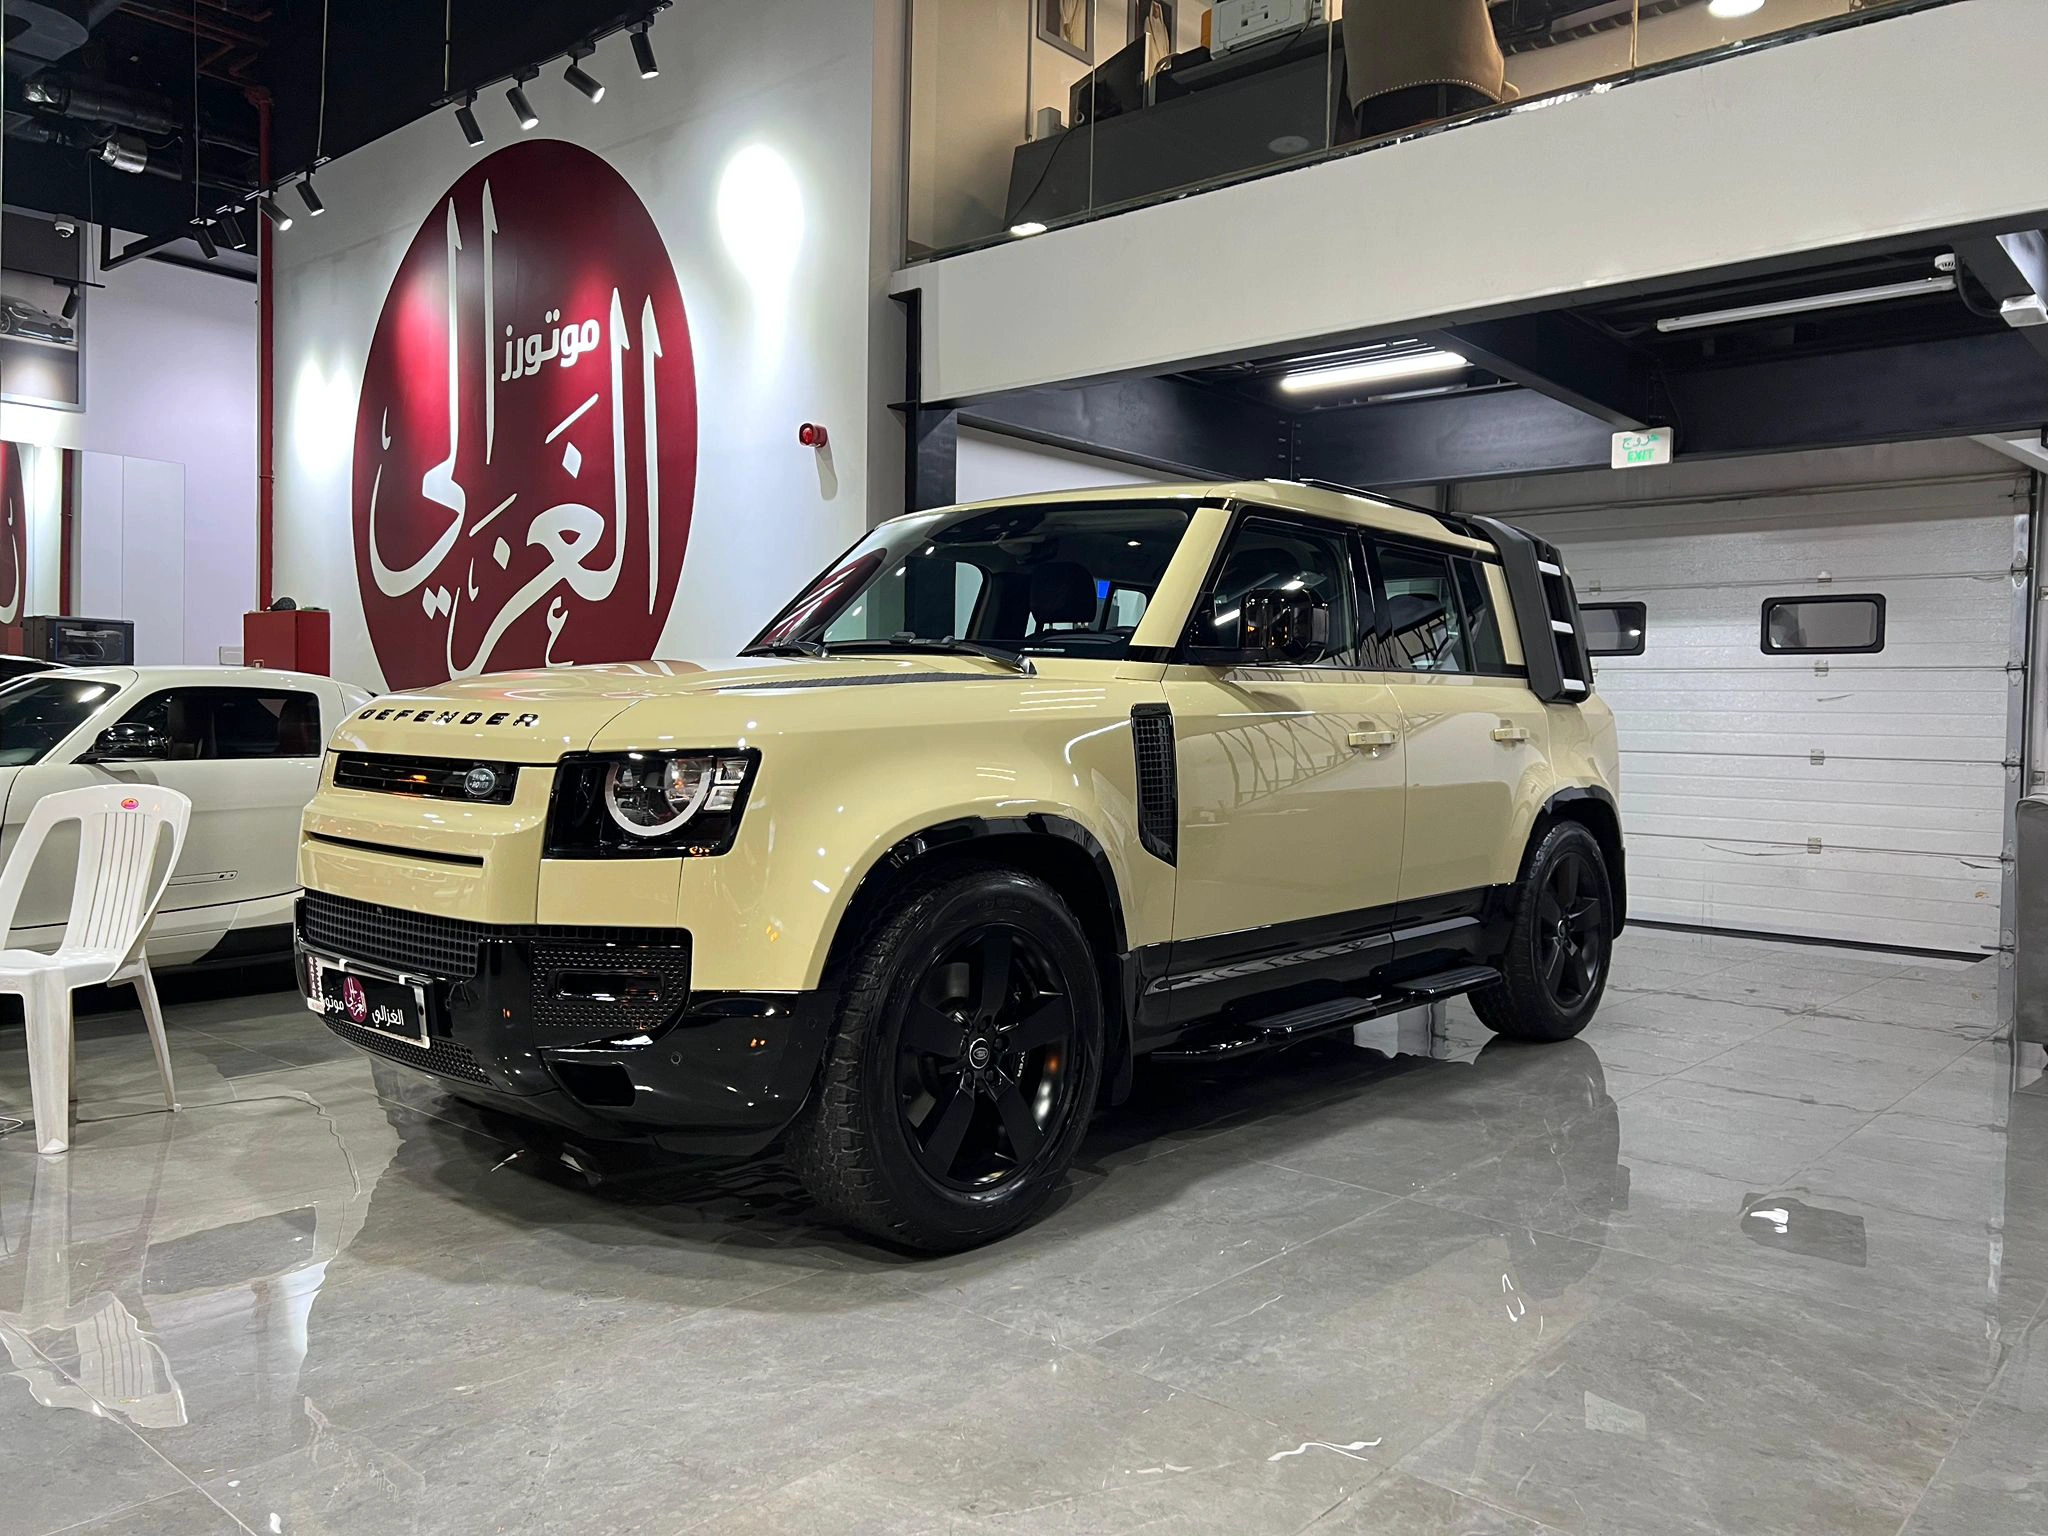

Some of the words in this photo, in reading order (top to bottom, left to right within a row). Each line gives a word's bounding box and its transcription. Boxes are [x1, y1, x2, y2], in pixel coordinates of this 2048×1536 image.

[502, 309, 600, 382] موتورز
[1623, 434, 1658, 450] خروج
[1628, 449, 1654, 463] EXIT
[358, 708, 540, 727] DEFENDER
[325, 995, 344, 1013] موتو
[372, 1005, 404, 1027] الغزالي
